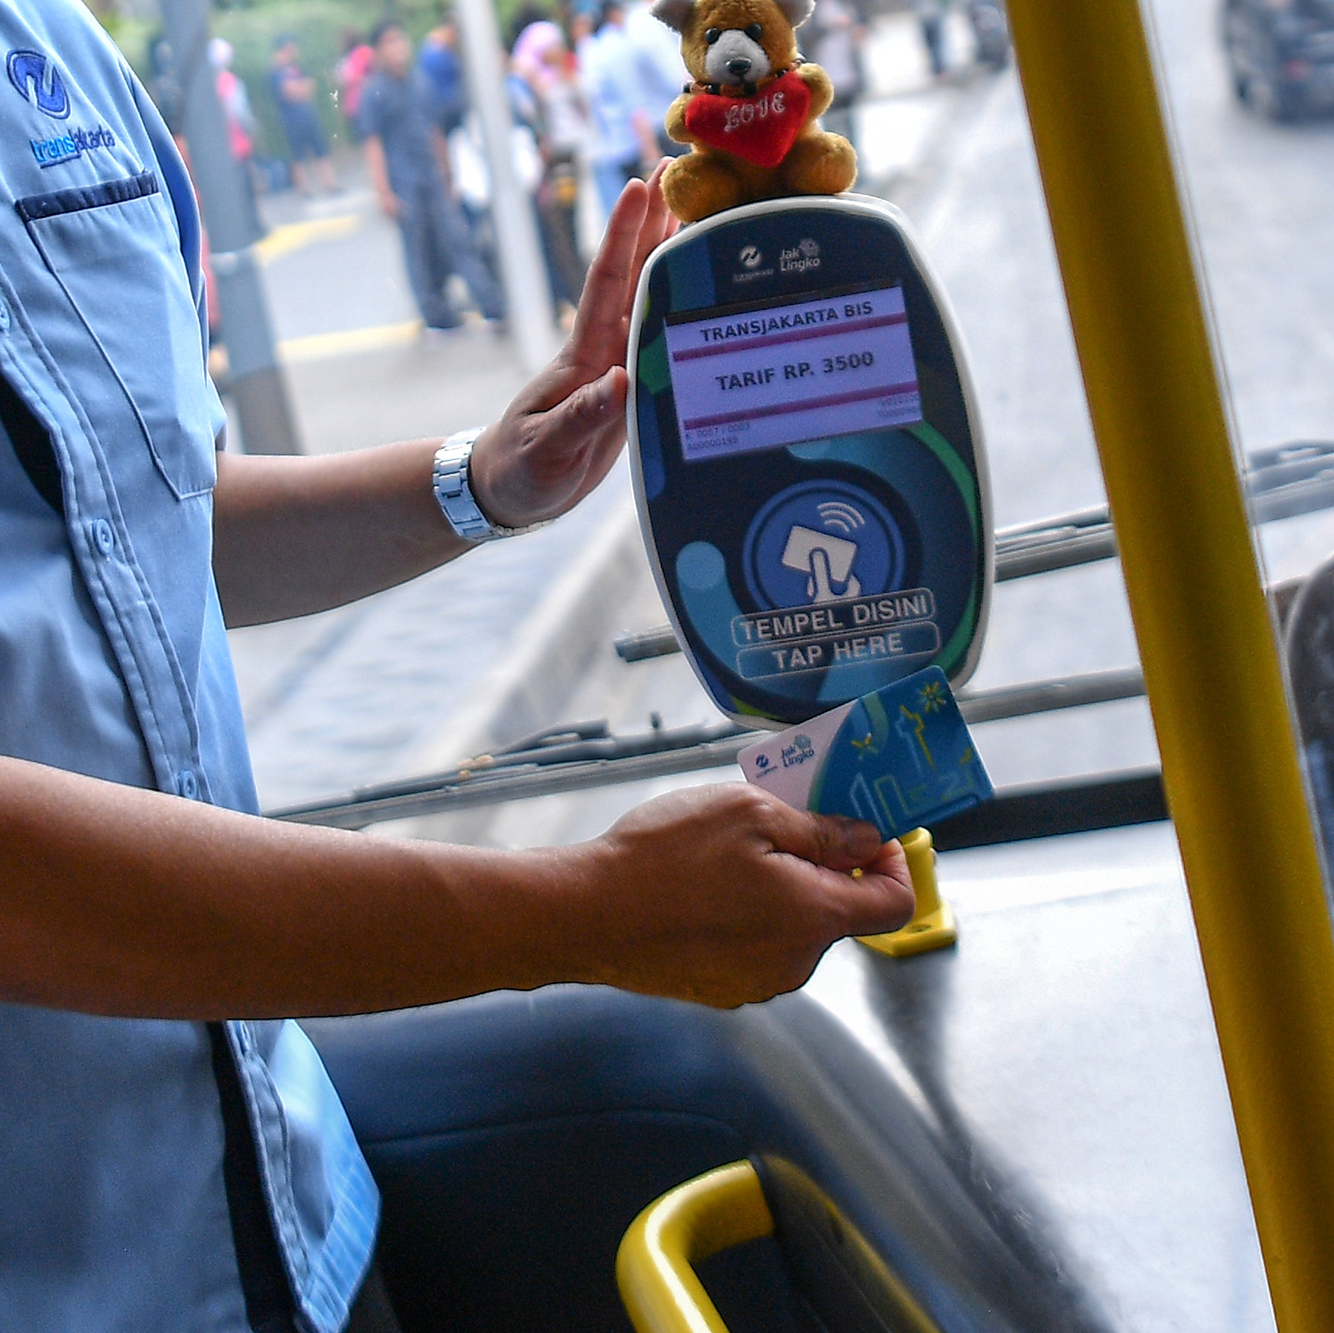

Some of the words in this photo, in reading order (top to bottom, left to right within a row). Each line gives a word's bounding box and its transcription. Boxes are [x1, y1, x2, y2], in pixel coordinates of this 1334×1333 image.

[700, 307, 838, 342] TRANSJAKARTA
[844, 301, 873, 317] BIS
[716, 368, 775, 391] TARIF
[784, 362, 814, 380] RP.
[823, 351, 873, 374] 3500
[740, 608, 843, 640] TEMPEL
[853, 595, 928, 625] DISINI
[772, 645, 822, 668] TAP
[833, 633, 903, 660] HERE
